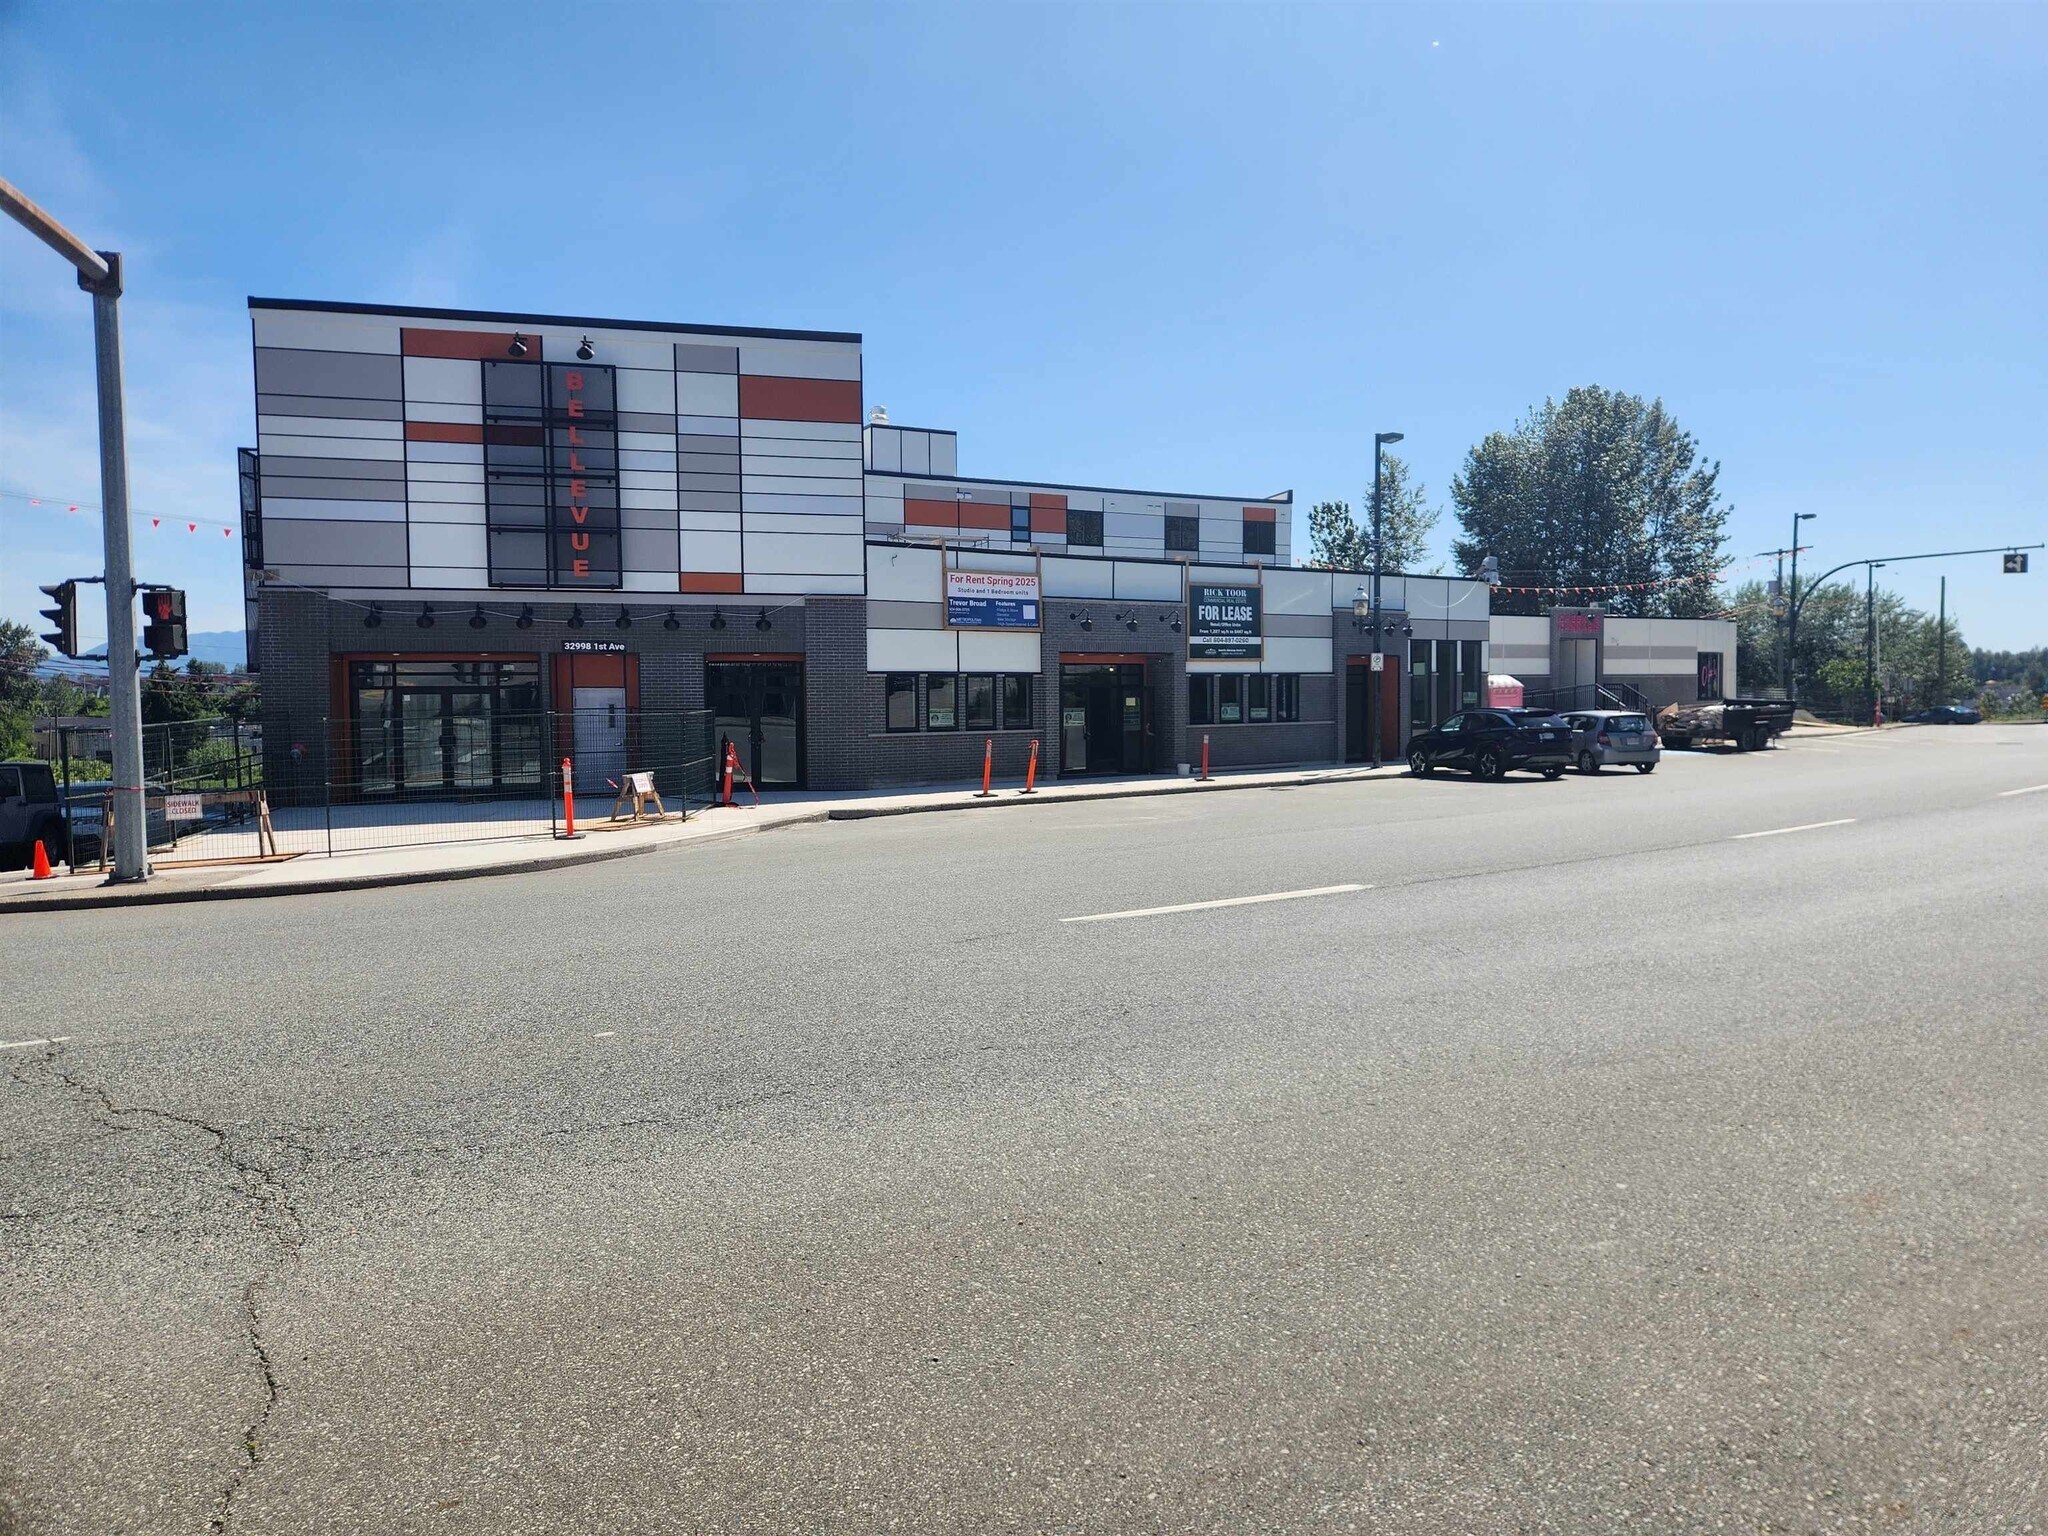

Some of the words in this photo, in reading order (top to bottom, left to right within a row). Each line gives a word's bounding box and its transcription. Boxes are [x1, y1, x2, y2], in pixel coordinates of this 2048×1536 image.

[566, 371, 590, 577] BELLEVUE
[950, 574, 964, 583] For
[966, 575, 985, 584] Rent
[987, 577, 1013, 587] Spring
[1015, 577, 1036, 586] 2025
[1225, 589, 1247, 597] TOOR
[1198, 605, 1220, 621] FOR
[1222, 605, 1253, 621] LEASE
[564, 642, 592, 650] 32998
[593, 642, 607, 650] 1st
[608, 642, 625, 651] Ave
[167, 800, 200, 808] SIDEWALK
[171, 807, 197, 815] CLOSED
